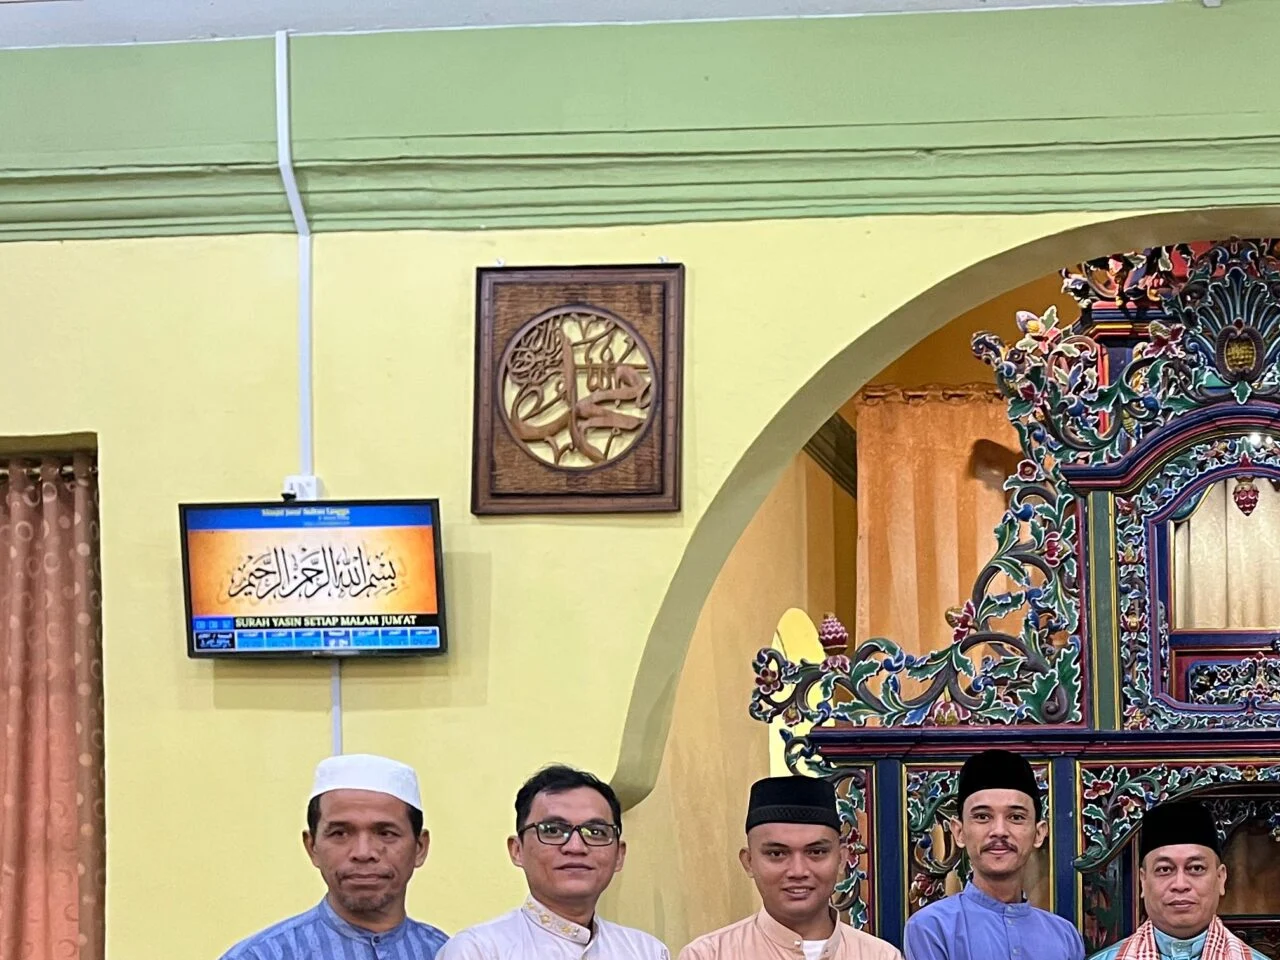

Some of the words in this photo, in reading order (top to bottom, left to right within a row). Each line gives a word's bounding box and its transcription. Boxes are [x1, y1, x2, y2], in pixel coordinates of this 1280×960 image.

[235, 617, 270, 628] SURAH
[272, 617, 302, 627] YASIN
[304, 616, 339, 627] SETIAP
[340, 615, 379, 626] MALAM
